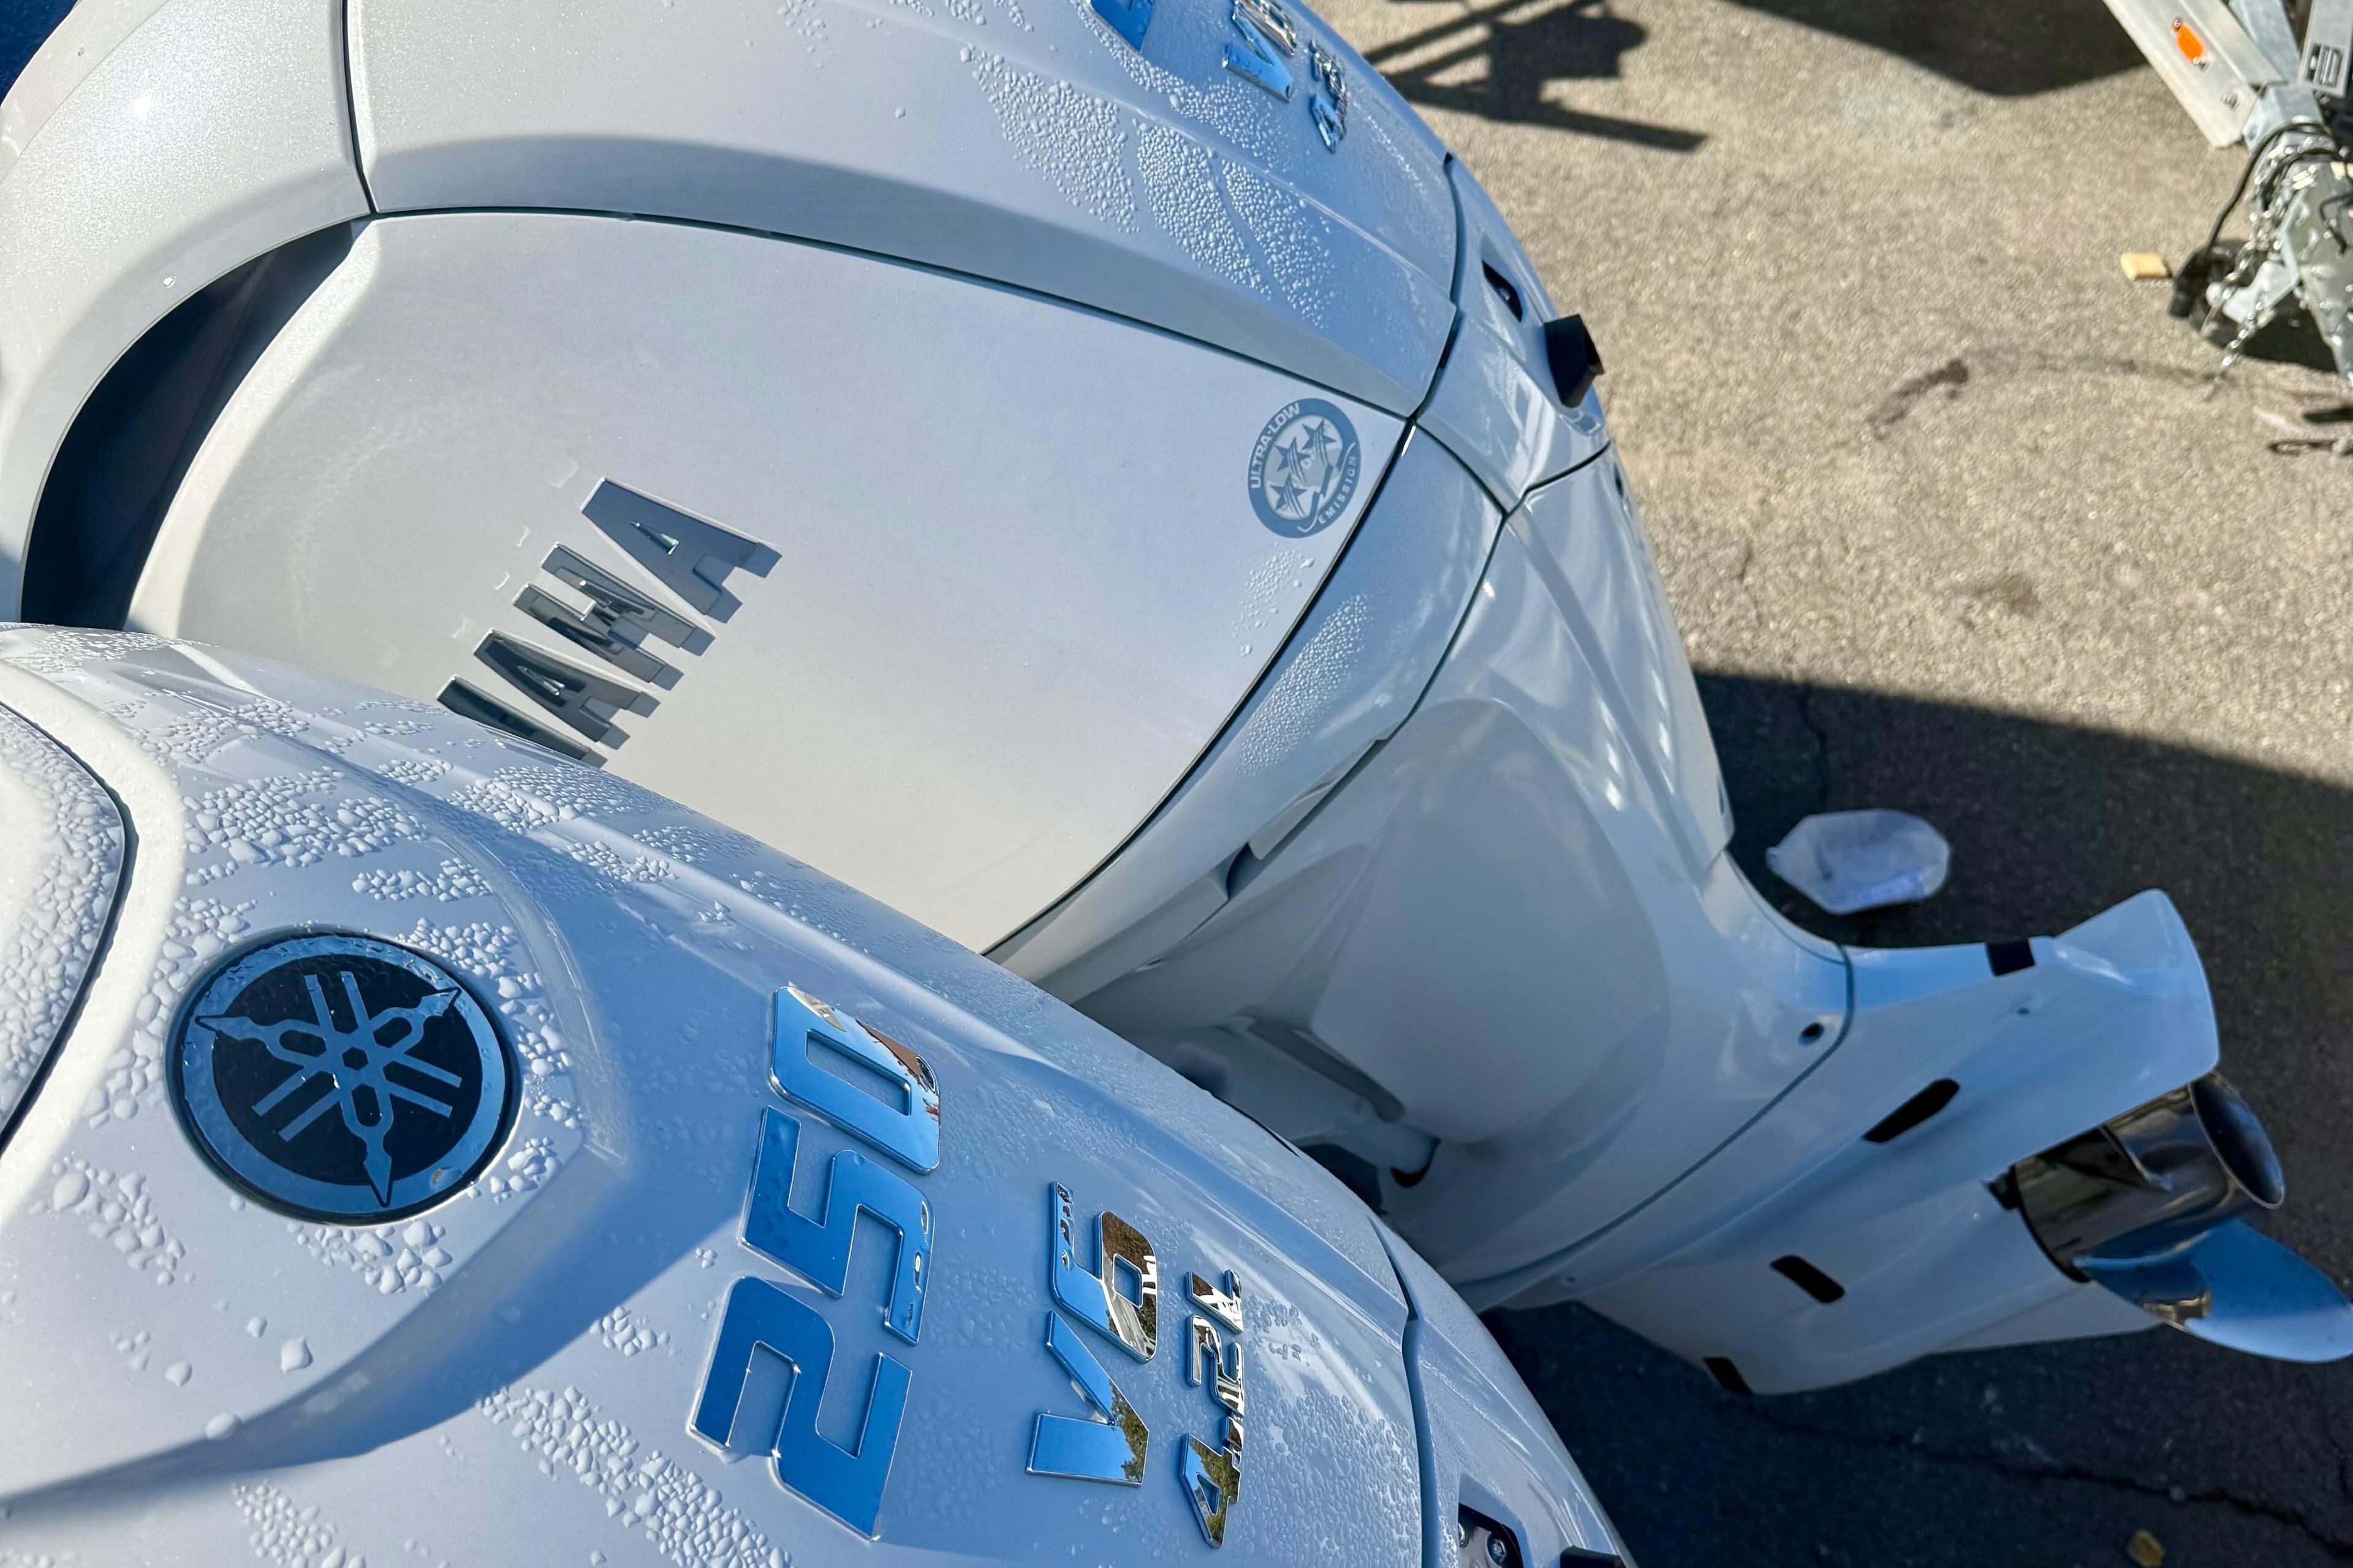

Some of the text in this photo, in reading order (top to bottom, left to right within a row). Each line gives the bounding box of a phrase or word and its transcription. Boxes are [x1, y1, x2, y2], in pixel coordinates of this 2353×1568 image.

[1318, 455, 1357, 525] EMISSION
[687, 986, 941, 1541] 250
[1026, 1180, 1158, 1487] V6
[1180, 1269, 1245, 1549] 4.2L
